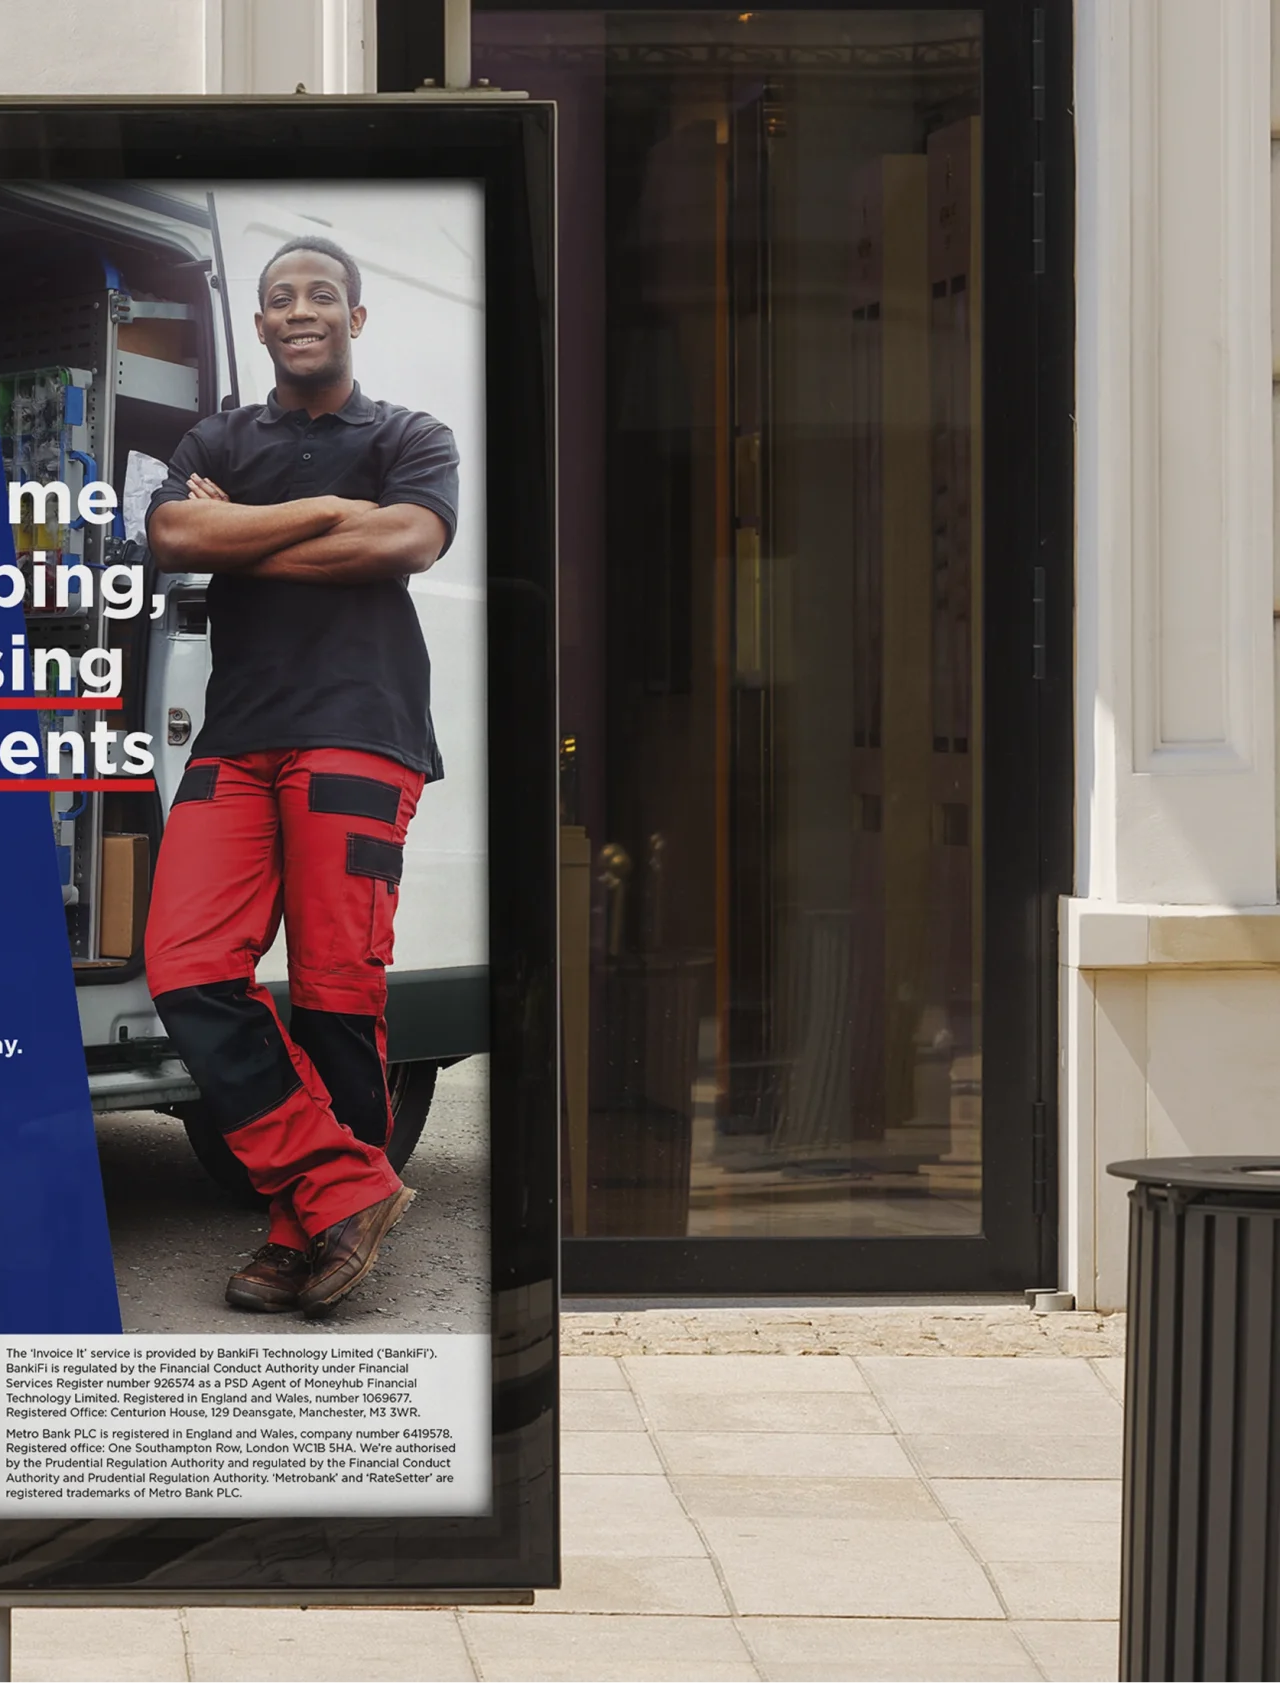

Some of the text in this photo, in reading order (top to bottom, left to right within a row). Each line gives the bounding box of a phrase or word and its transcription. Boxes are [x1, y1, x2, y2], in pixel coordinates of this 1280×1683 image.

[6, 1348, 27, 1358] The
[91, 1349, 130, 1358] service
[134, 1349, 142, 1358] is
[146, 1349, 196, 1360] provided
[200, 1349, 214, 1360] by
[218, 1348, 258, 1358] BankiFi
[262, 1348, 327, 1360] Technology
[331, 1349, 373, 1358] Limited
[7, 1363, 408, 1375] BankiFi is regulated by the Financial Conduct Authority under Financial
[6, 1378, 416, 1390] Services Register number 926574 as a PSD Agent of Moneyhub Financial
[6, 1393, 411, 1405] Technology Limited. Registered in England and Wales, number 1069677.
[7, 1407, 420, 1419] Registered Office: Centurion House, 129 Deansgate, Manchester, M3 3WR.
[6, 1429, 452, 1440] Metro Bank PLC is registered in England and Wales, company number 6419578.
[7, 1443, 66, 1455] Registered
[70, 1443, 104, 1452] office:
[109, 1443, 131, 1452] One
[136, 1443, 212, 1454] Southampton
[216, 1443, 242, 1453] Row,
[246, 1443, 289, 1452] London
[293, 1443, 325, 1452] WC1B
[329, 1443, 356, 1452] 5HA.
[395, 1443, 455, 1452] authorised
[6, 1458, 450, 1470] by the Prudential Regulation Authority and regulated by the Financial Conduct
[6, 1473, 60, 1484] Authority
[63, 1473, 84, 1482] and
[88, 1473, 145, 1482] Prudential
[149, 1473, 209, 1485] Regulation
[213, 1473, 269, 1485] Authority.
[341, 1473, 363, 1482] and
[6, 1488, 242, 1500] registered trademarks of Metro Bank PLC.
